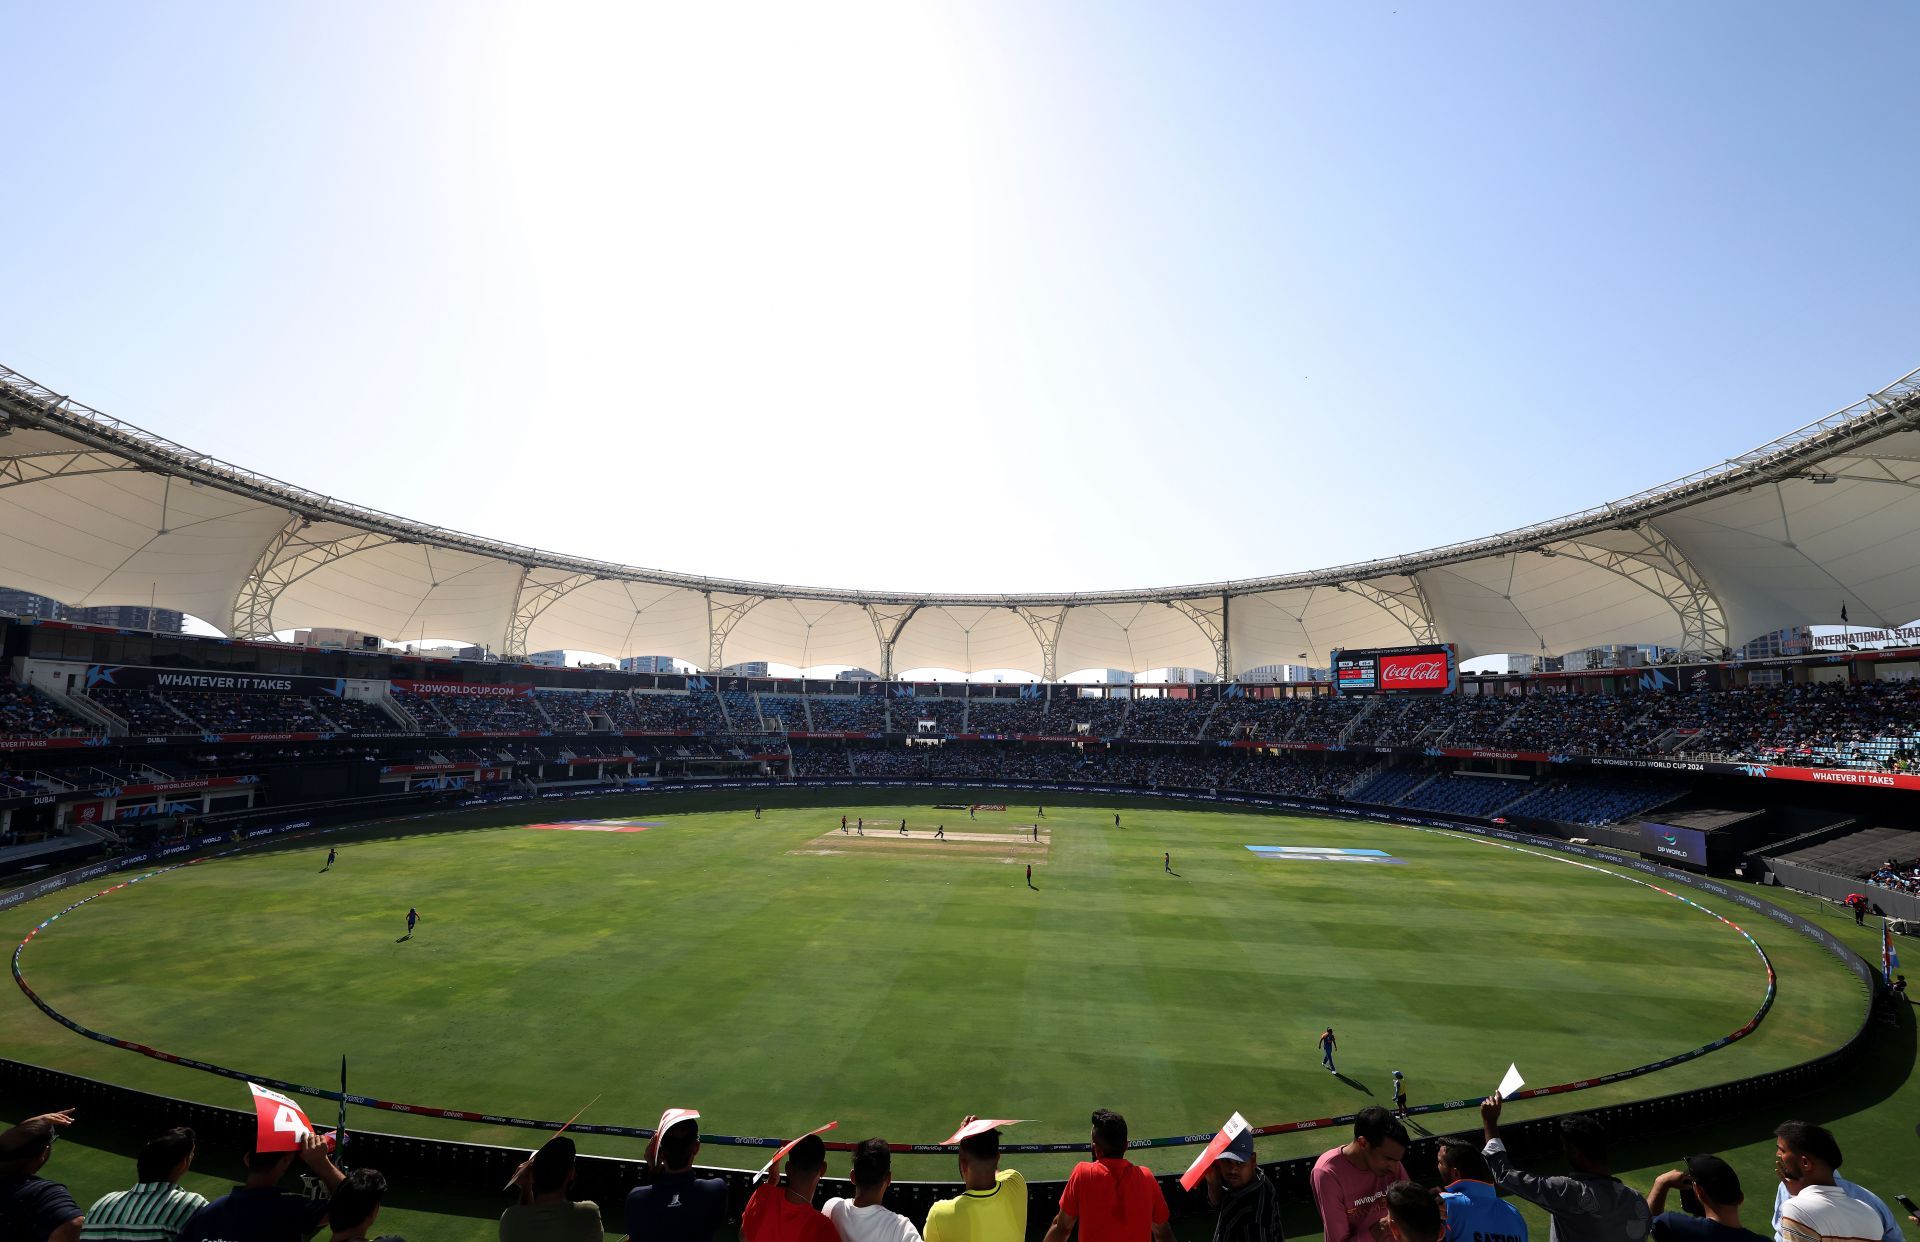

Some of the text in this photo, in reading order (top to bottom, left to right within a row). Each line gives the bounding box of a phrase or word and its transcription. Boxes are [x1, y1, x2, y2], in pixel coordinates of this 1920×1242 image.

[1815, 630, 1891, 646] INTERNATIONAL
[157, 674, 292, 690] WHATEVER IT TAKES
[412, 683, 514, 696] T20WORLDCUP.COM
[1472, 751, 1518, 759] #T20WORLDCUP
[1604, 759, 1633, 767] WOMEN'S
[1634, 760, 1646, 768] T20
[1647, 761, 1671, 769] WORLD
[1812, 772, 1895, 786] WHATEVER IT TAKES
[153, 781, 209, 791] T20WORLDCUP.COM
[34, 795, 56, 805] DUBAI
[202, 836, 222, 844] WORLD
[1537, 839, 1553, 847] WORLD
[172, 845, 191, 853] WORLD
[1666, 847, 1688, 858] WORLD
[130, 854, 147, 864] WORLD
[1605, 855, 1623, 863] WORLD
[81, 865, 107, 878] DP WORLD
[1641, 863, 1656, 872] WORLD
[1675, 873, 1692, 883] WORLD
[49, 878, 67, 890] WORLD
[1711, 885, 1728, 895] WORLD
[4, 892, 24, 904] WORLD
[1745, 897, 1761, 909] WORLD
[1779, 912, 1794, 924] WORLD
[1811, 928, 1824, 941] WORLD
[299, 1086, 320, 1095] aramco
[345, 1095, 364, 1103] ramco
[391, 1103, 411, 1112] Emirates
[274, 1104, 310, 1143] 4
[1296, 1121, 1317, 1129] Emirates
[735, 1137, 763, 1145] aramco
[1128, 1139, 1151, 1147] ramco
[1185, 1134, 1210, 1142] aramco
